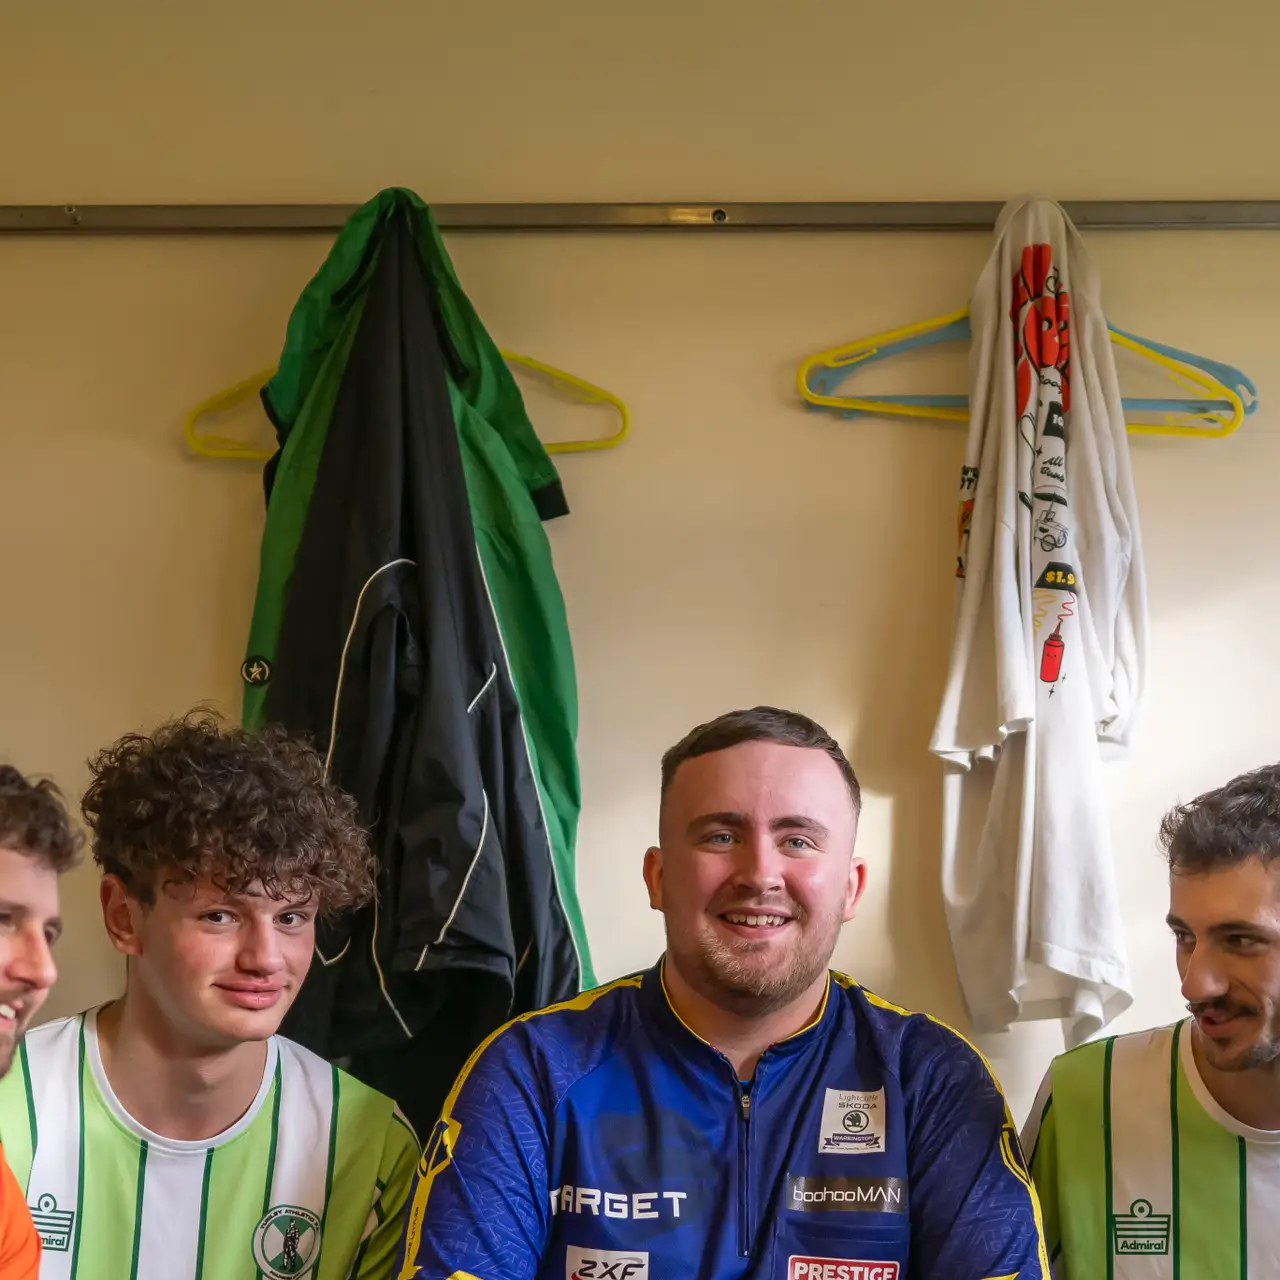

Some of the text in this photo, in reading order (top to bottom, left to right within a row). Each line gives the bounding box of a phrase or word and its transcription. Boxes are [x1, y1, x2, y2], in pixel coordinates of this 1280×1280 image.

[833, 1134, 874, 1142] WARRINGTON
[792, 1185, 901, 1204] boohooMAN
[549, 1184, 688, 1220] TARGET
[41, 1235, 66, 1247] miral
[1120, 1239, 1164, 1251] Admiral
